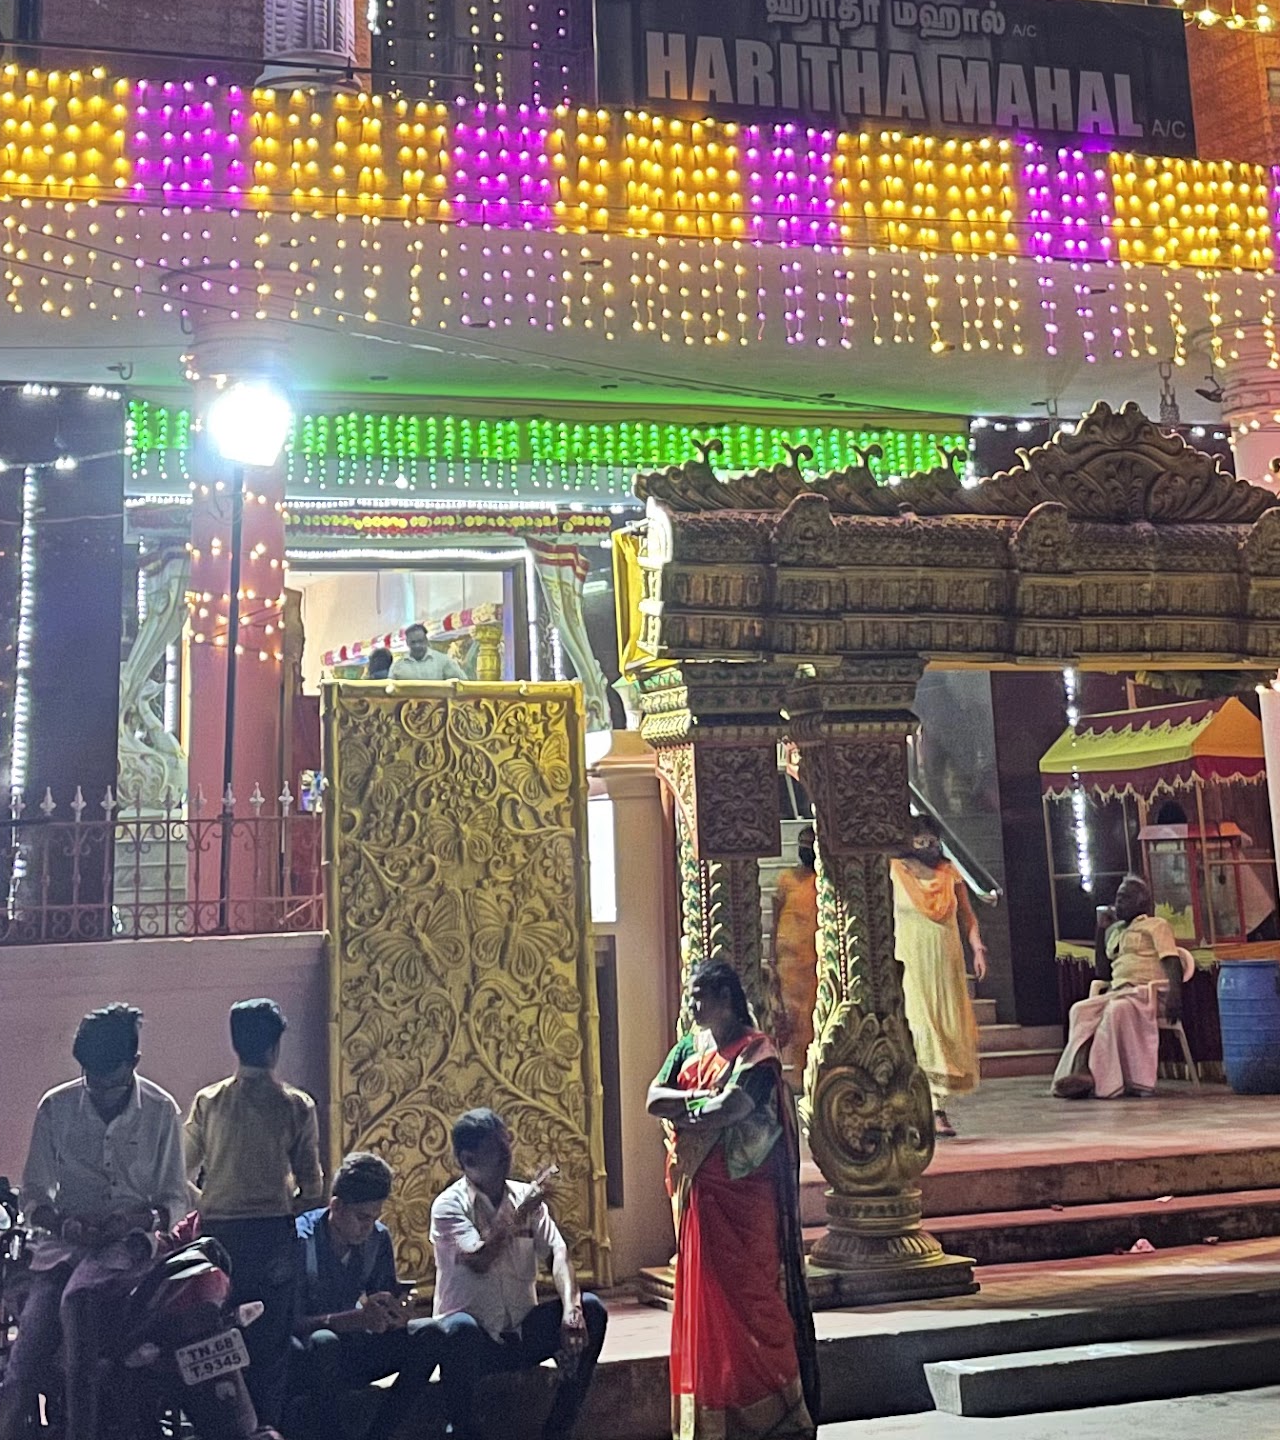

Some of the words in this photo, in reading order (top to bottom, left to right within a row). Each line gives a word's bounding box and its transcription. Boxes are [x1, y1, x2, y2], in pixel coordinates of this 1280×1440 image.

[893, 0, 1006, 38] மஹால்
[1012, 24, 1037, 38] A/C
[646, 30, 926, 119] HARITHA
[940, 57, 1143, 137] MAHAL
[1151, 120, 1186, 139] A/C
